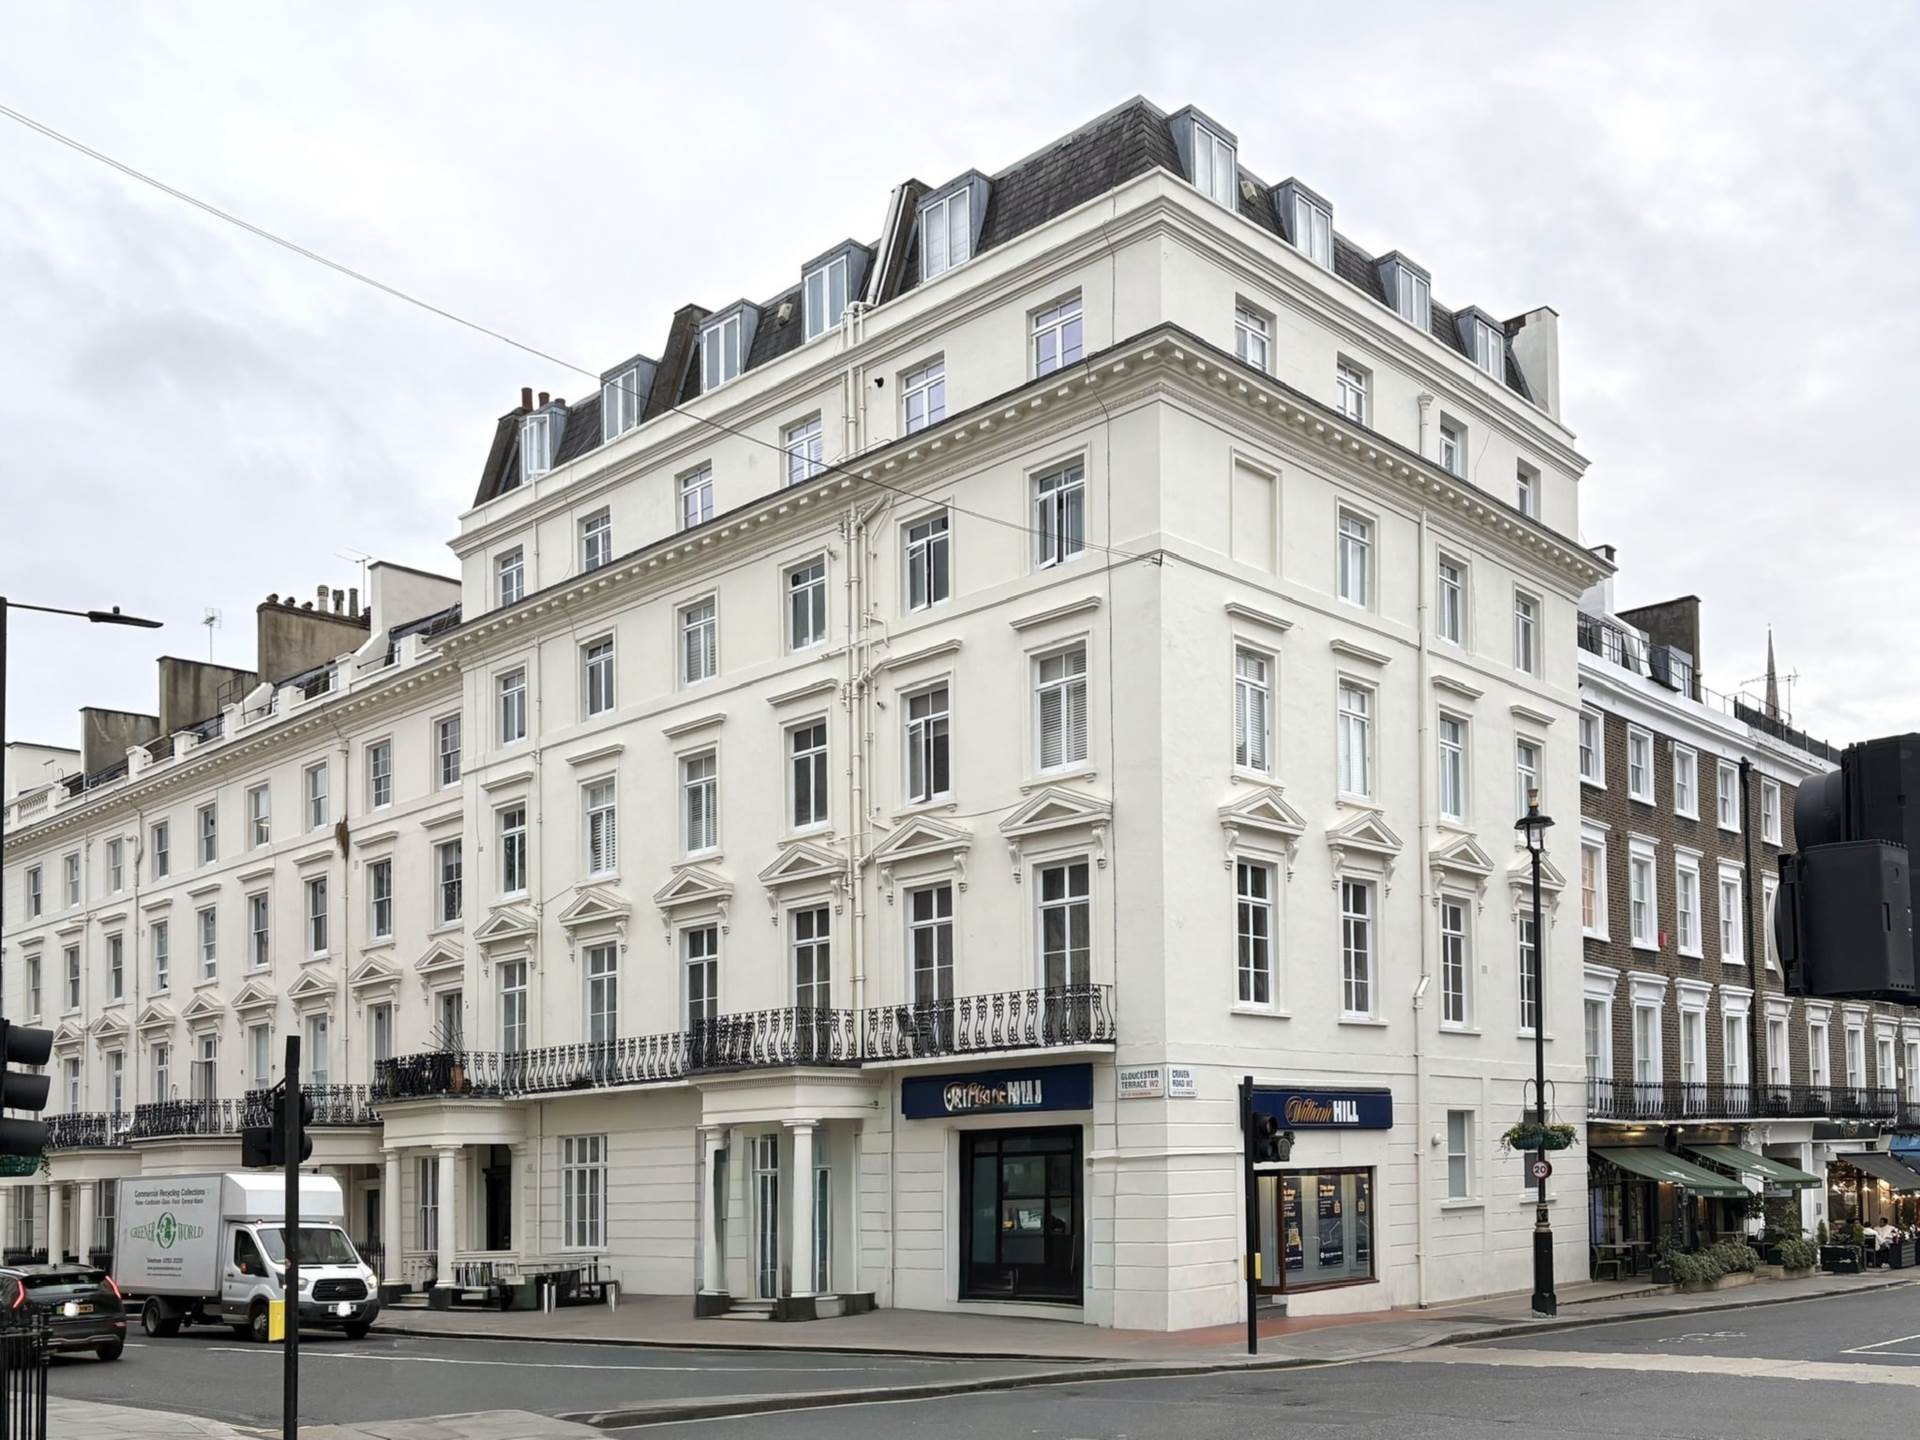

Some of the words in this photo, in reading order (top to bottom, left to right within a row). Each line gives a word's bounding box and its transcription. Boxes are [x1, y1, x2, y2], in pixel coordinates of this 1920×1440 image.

[1120, 1070, 1159, 1081] GLOUCESTER
[1121, 1080, 1148, 1089] TERRACE
[1149, 1080, 1160, 1088] W2
[1172, 1079, 1185, 1087] ROAD
[1285, 1096, 1333, 1125] William
[1333, 1101, 1359, 1122] HILL
[1534, 1165, 1547, 1174] 20
[160, 1189, 180, 1198] Recycling
[181, 1188, 205, 1196] Collections
[130, 1222, 155, 1241] GREENER
[177, 1222, 204, 1241] WORLD
